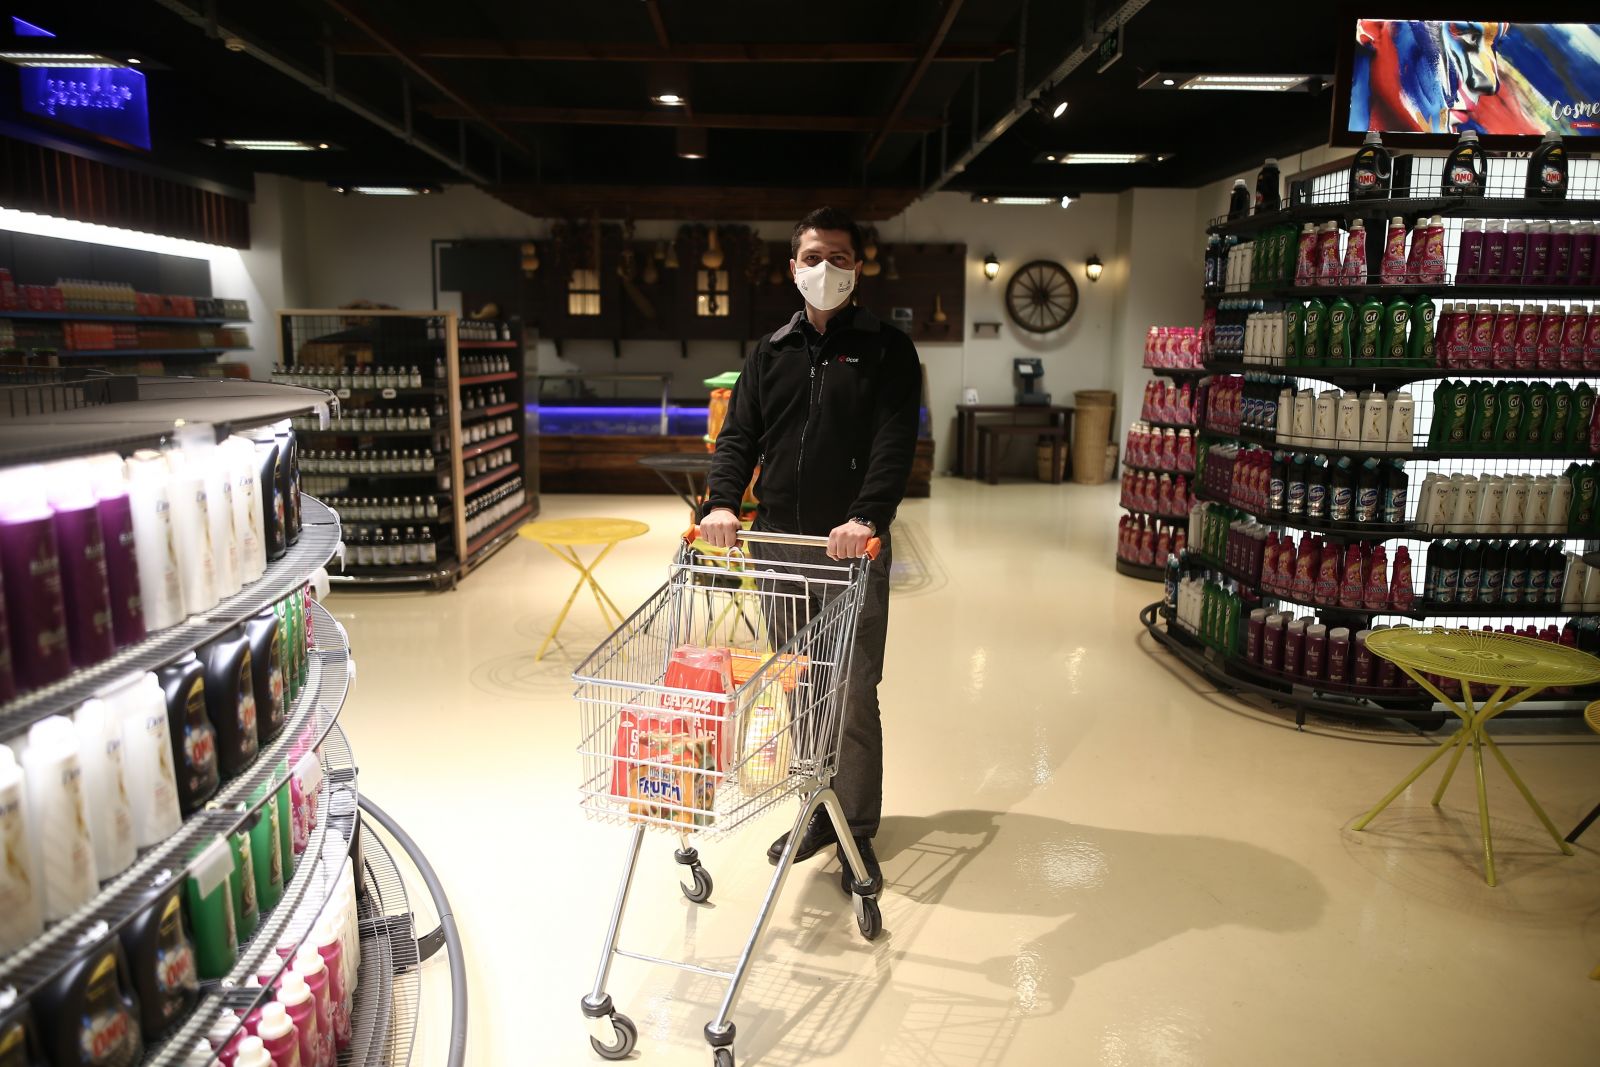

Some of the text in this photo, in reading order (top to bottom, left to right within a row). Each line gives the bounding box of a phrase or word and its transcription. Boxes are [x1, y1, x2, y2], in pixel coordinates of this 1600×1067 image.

[1358, 173, 1377, 185] OMO
[1454, 172, 1474, 183] OMO
[1545, 173, 1562, 183] OMO
[1333, 312, 1345, 323] Cif
[1366, 311, 1378, 323] Cif
[1395, 311, 1407, 322] Cif
